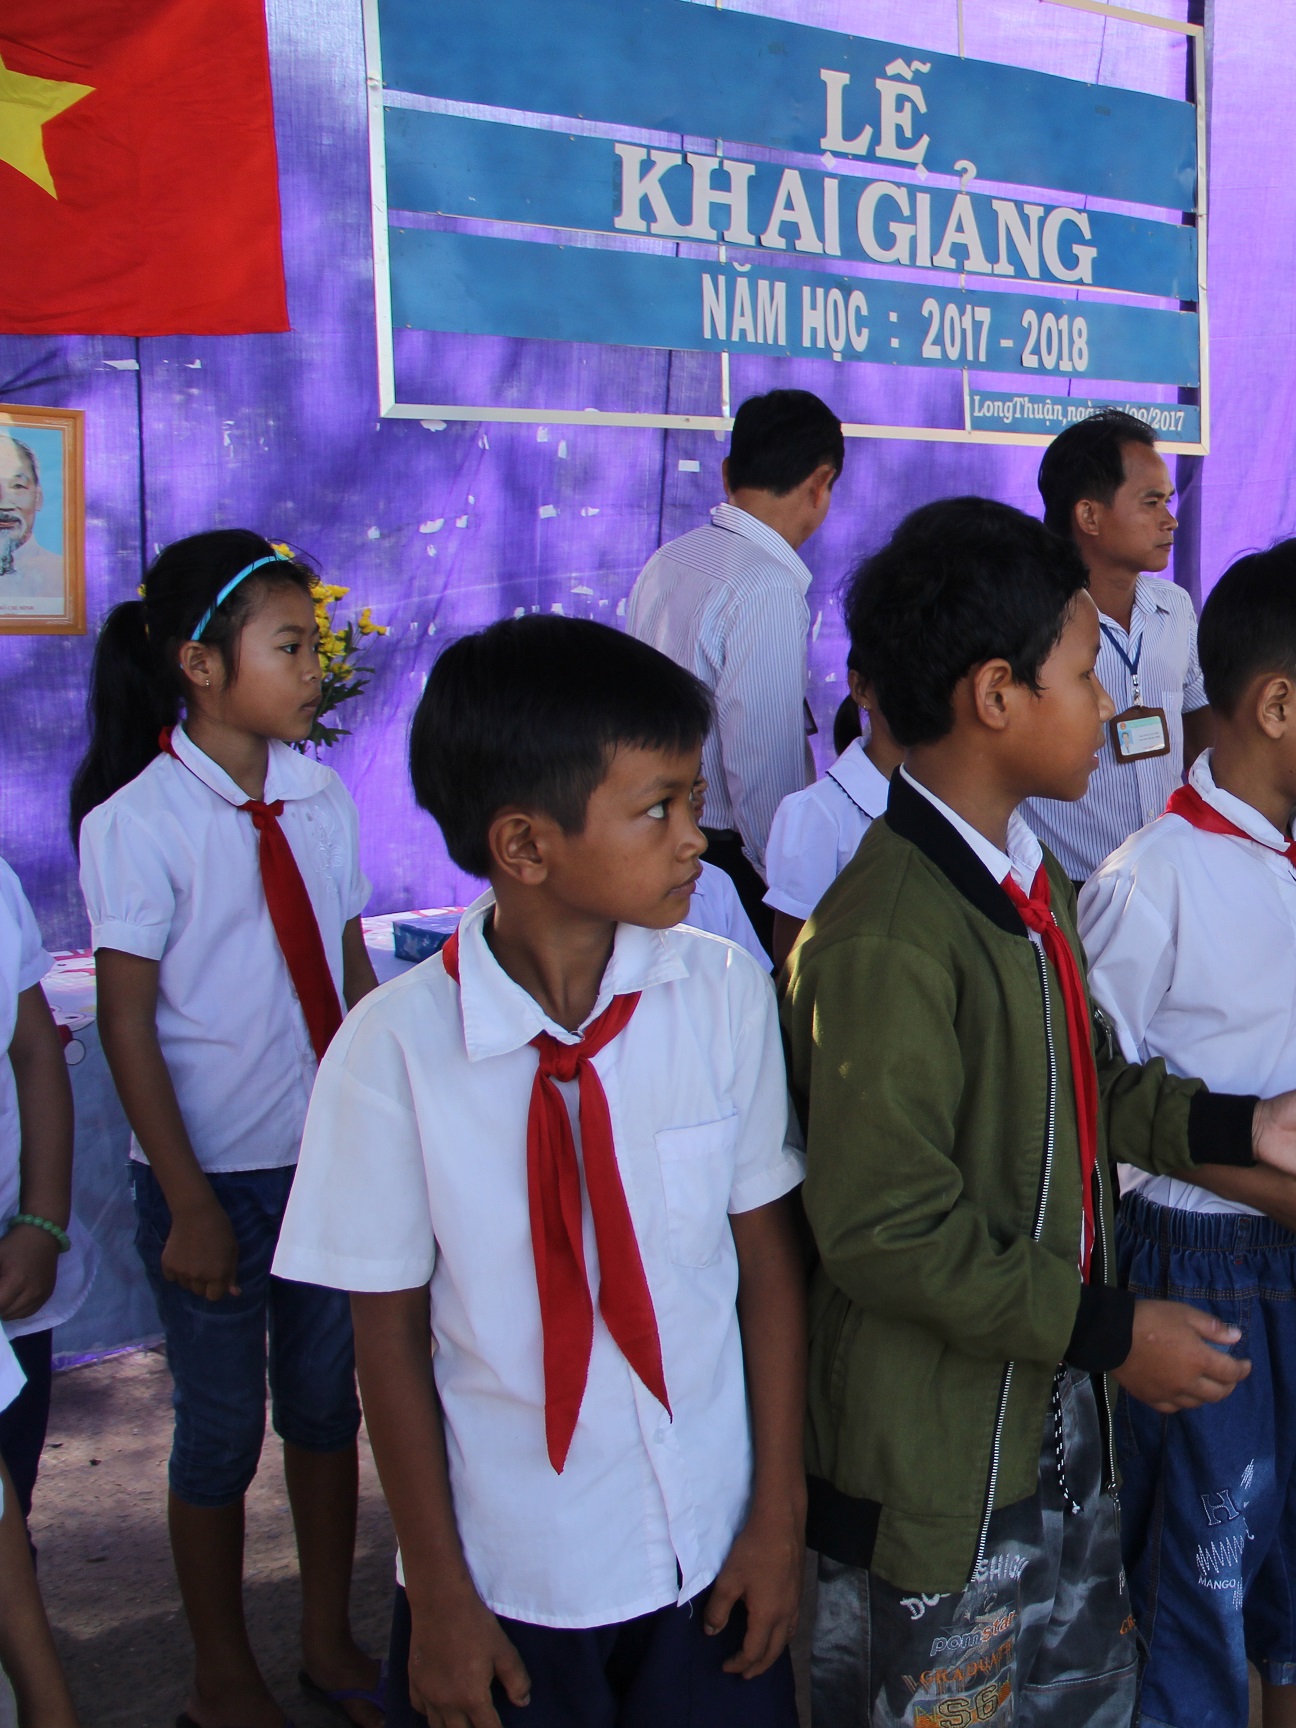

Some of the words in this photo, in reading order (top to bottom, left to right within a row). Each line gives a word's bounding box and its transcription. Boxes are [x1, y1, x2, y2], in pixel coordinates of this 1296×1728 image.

[820, 58, 931, 174] LỄ
[614, 142, 842, 256] KHAI
[857, 160, 1097, 284] GIẢNG
[702, 262, 787, 346] NĂM
[802, 285, 869, 362] HỌC
[921, 298, 991, 363] 2017
[1021, 308, 1089, 372] 2018
[1198, 1577, 1237, 1590] MANGO
